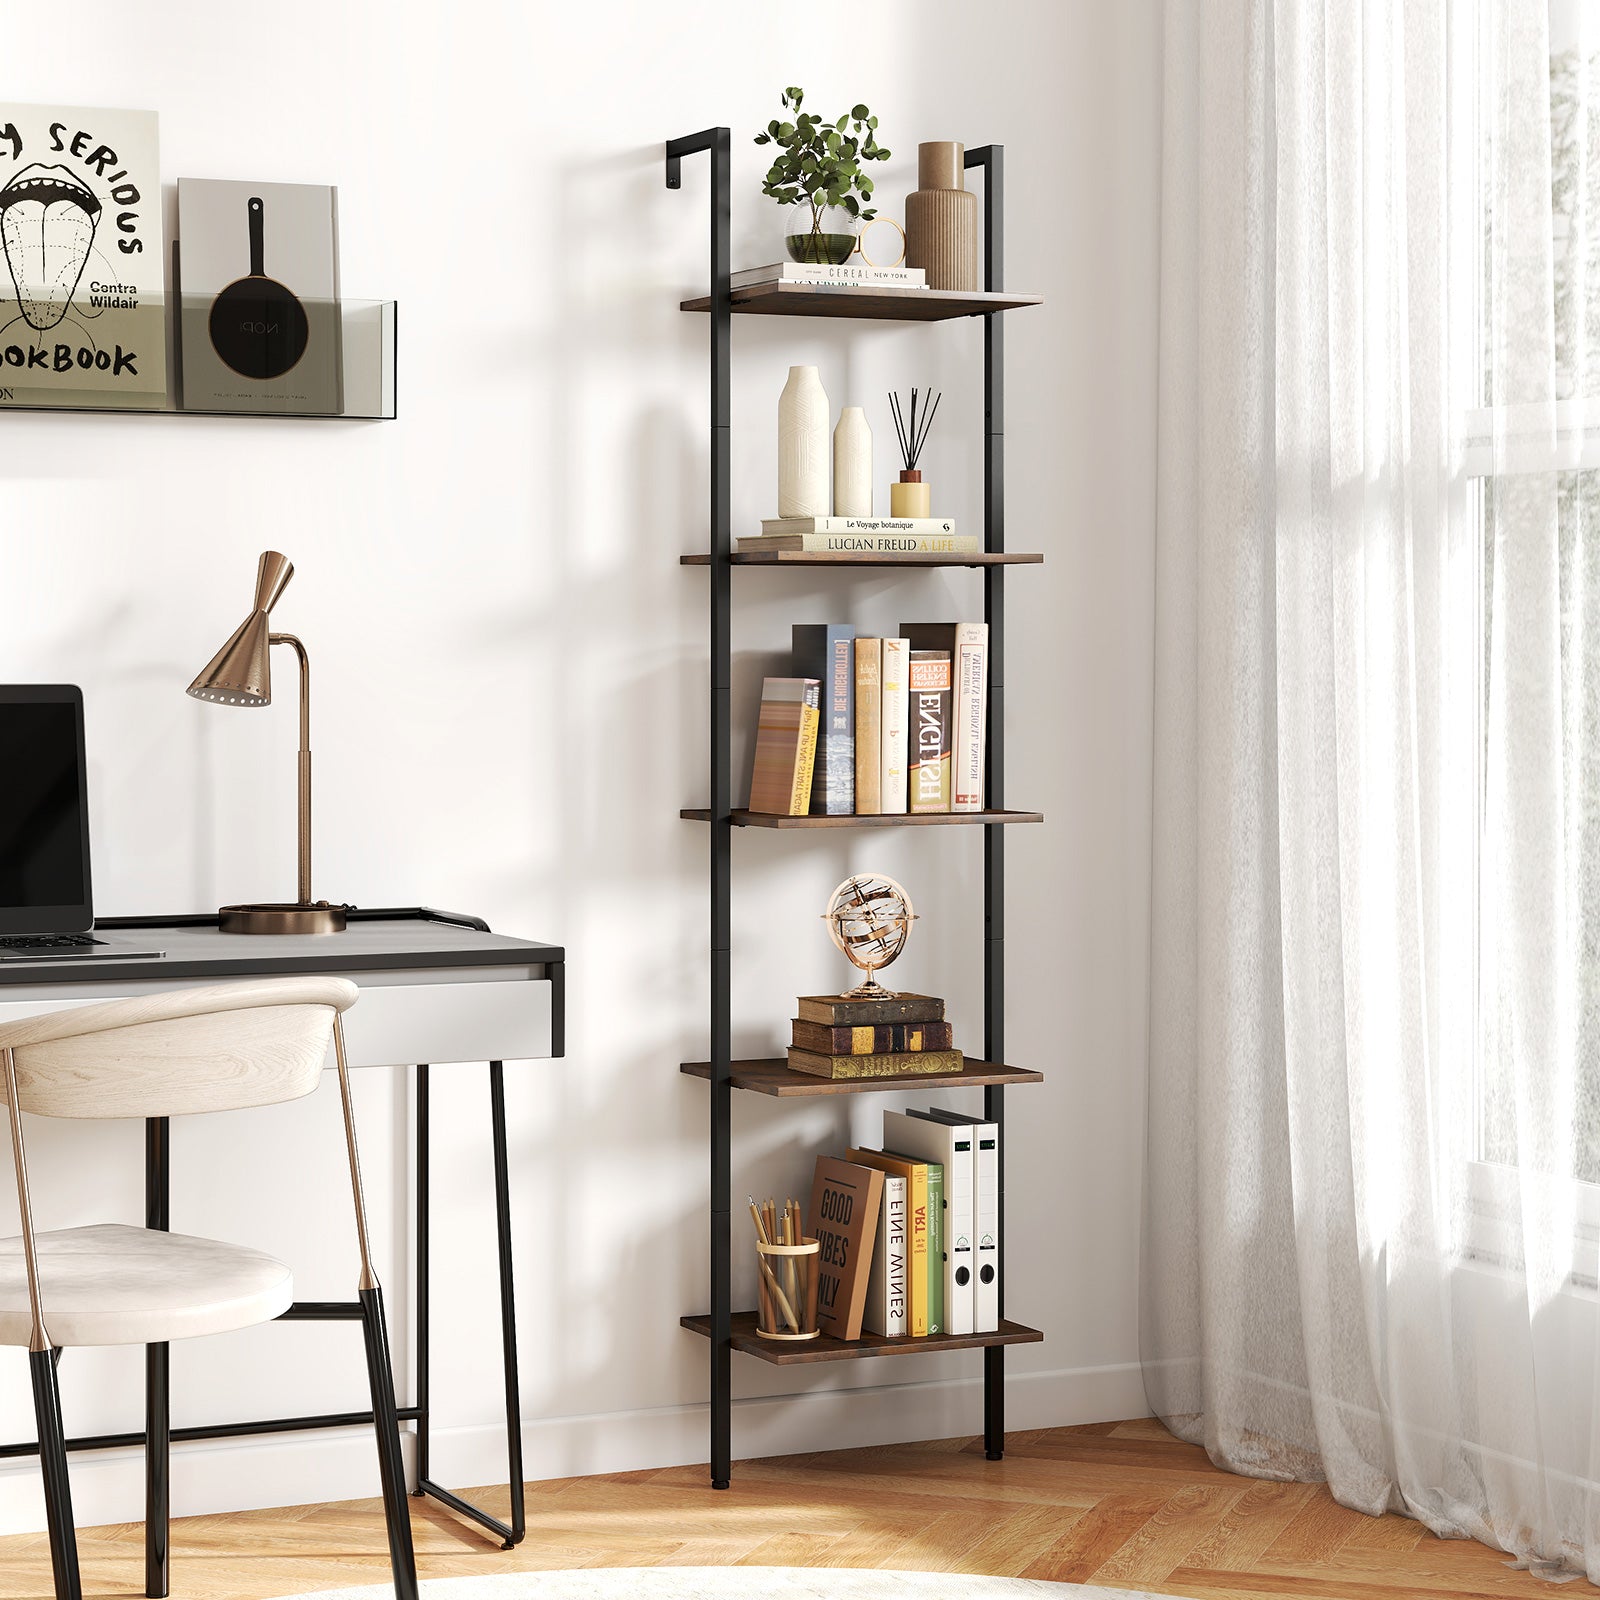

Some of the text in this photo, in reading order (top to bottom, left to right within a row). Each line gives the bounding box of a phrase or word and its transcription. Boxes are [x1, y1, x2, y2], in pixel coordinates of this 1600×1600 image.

[49, 122, 143, 255] SERIOUS
[829, 268, 869, 278] CEREAL
[90, 281, 137, 294] Contra
[90, 295, 139, 309] Wildair
[857, 521, 880, 530] Voyage
[881, 521, 914, 530] botanique
[828, 538, 953, 551] LUCIAN FREUD A LIFE
[821, 1188, 853, 1226] GOOD
[818, 1273, 840, 1308] NLY
